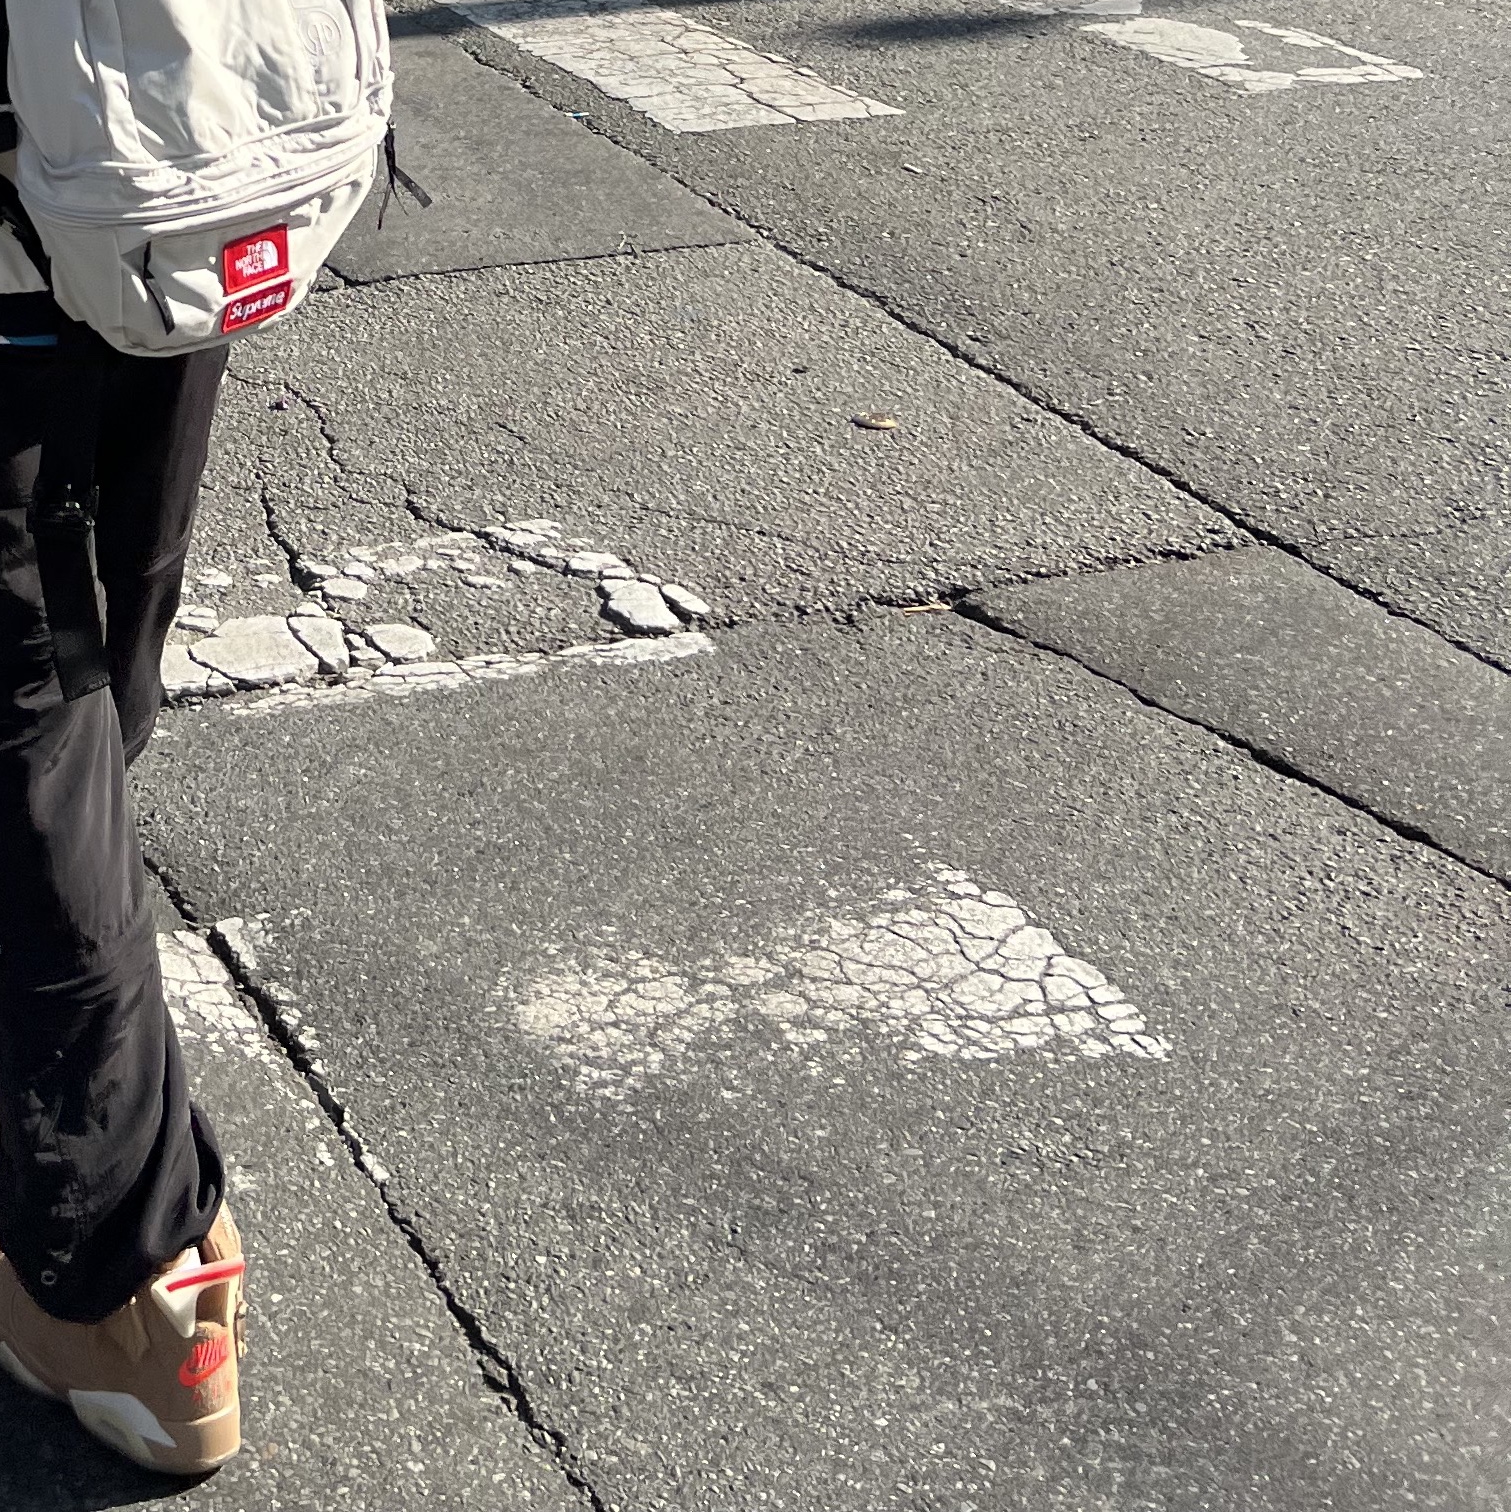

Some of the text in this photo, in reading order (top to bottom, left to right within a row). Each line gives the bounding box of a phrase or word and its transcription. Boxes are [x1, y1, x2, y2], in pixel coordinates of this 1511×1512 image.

[246, 240, 263, 255] THE
[234, 252, 263, 271] NORTH
[242, 263, 264, 278] FACE
[229, 291, 286, 321] Supreme
